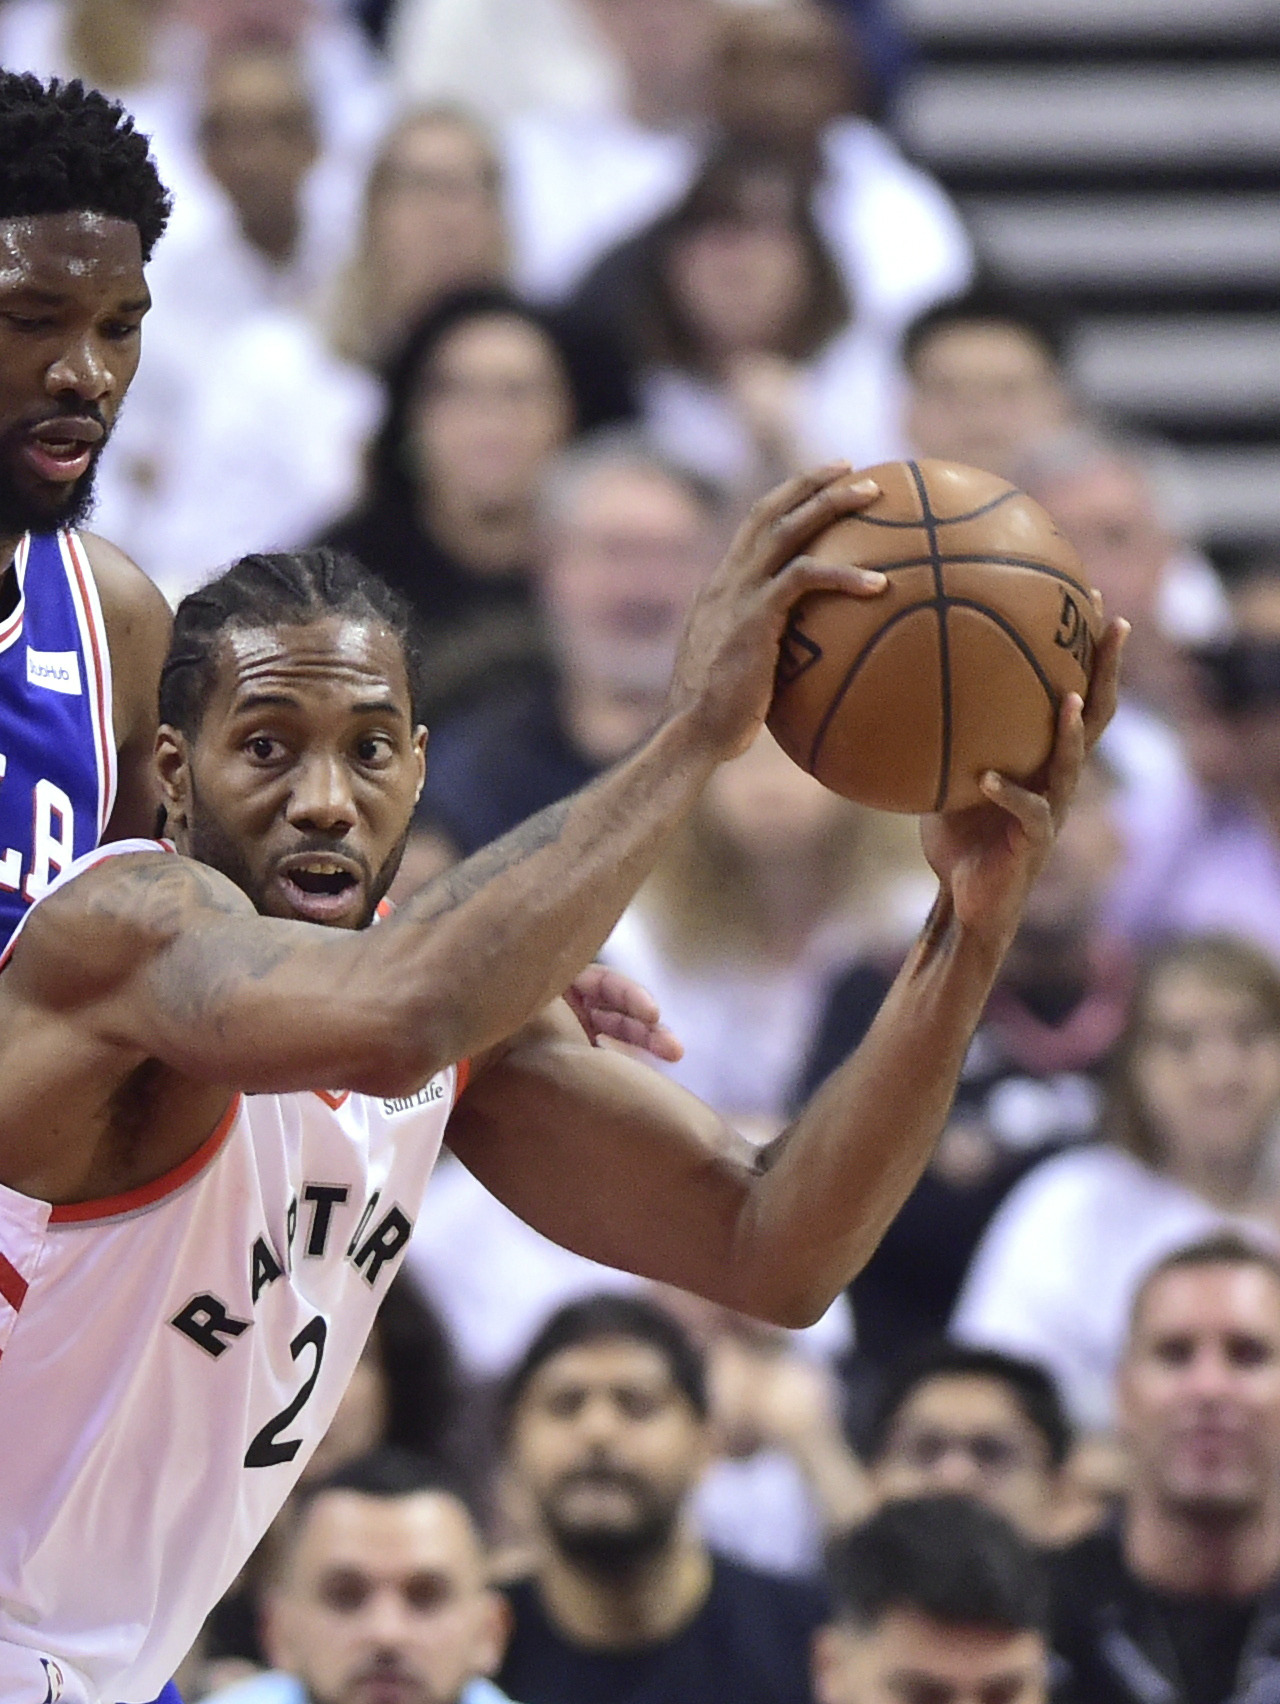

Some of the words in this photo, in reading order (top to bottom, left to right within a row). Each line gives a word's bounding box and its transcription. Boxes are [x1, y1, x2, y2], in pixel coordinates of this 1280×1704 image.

[383, 1096, 414, 1115] Sun
[417, 1081, 444, 1106] Life
[243, 1315, 327, 1468] 2
